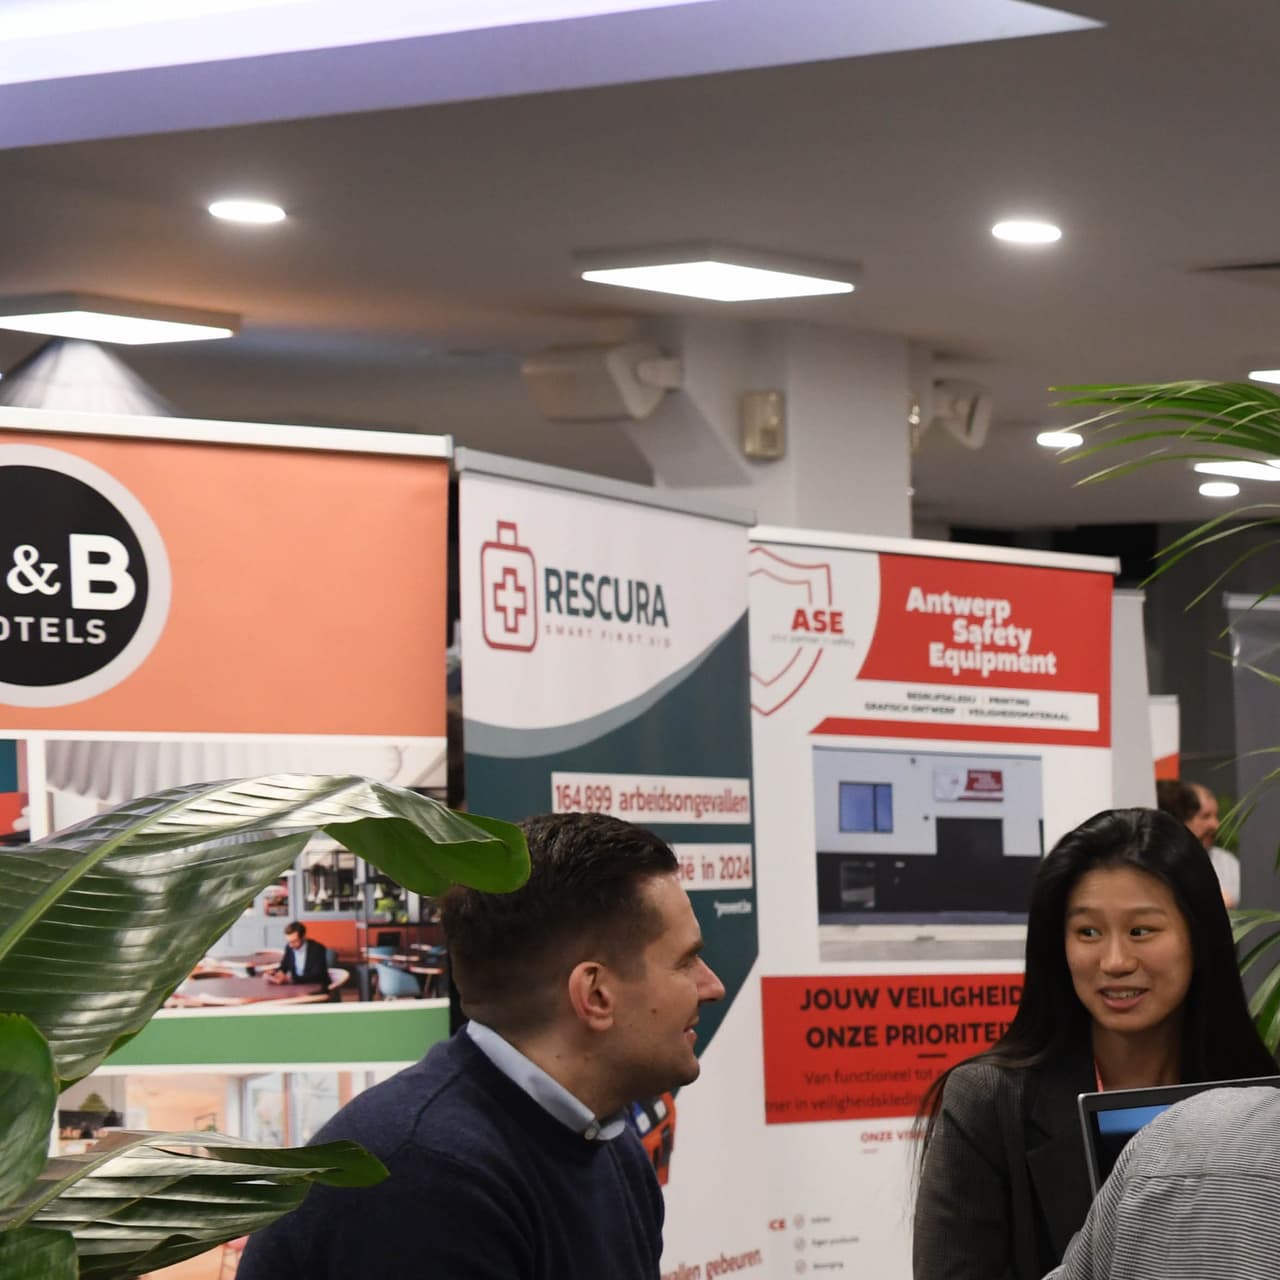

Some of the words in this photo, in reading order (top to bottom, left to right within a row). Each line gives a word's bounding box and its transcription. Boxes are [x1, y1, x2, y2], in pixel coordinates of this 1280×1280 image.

[544, 567, 669, 629] RESCURA
[906, 586, 1011, 625] Antwerp
[791, 608, 844, 634] ASE
[952, 617, 1032, 655] Safety
[928, 641, 1057, 678] Equipment
[555, 785, 612, 811] 164.899
[619, 786, 748, 818] arbeidsongevallen
[702, 856, 715, 881] in
[719, 855, 750, 880] 2024
[800, 988, 879, 1011] JOUW
[806, 1025, 878, 1049] ONZE
[860, 1131, 893, 1143] ONZE
